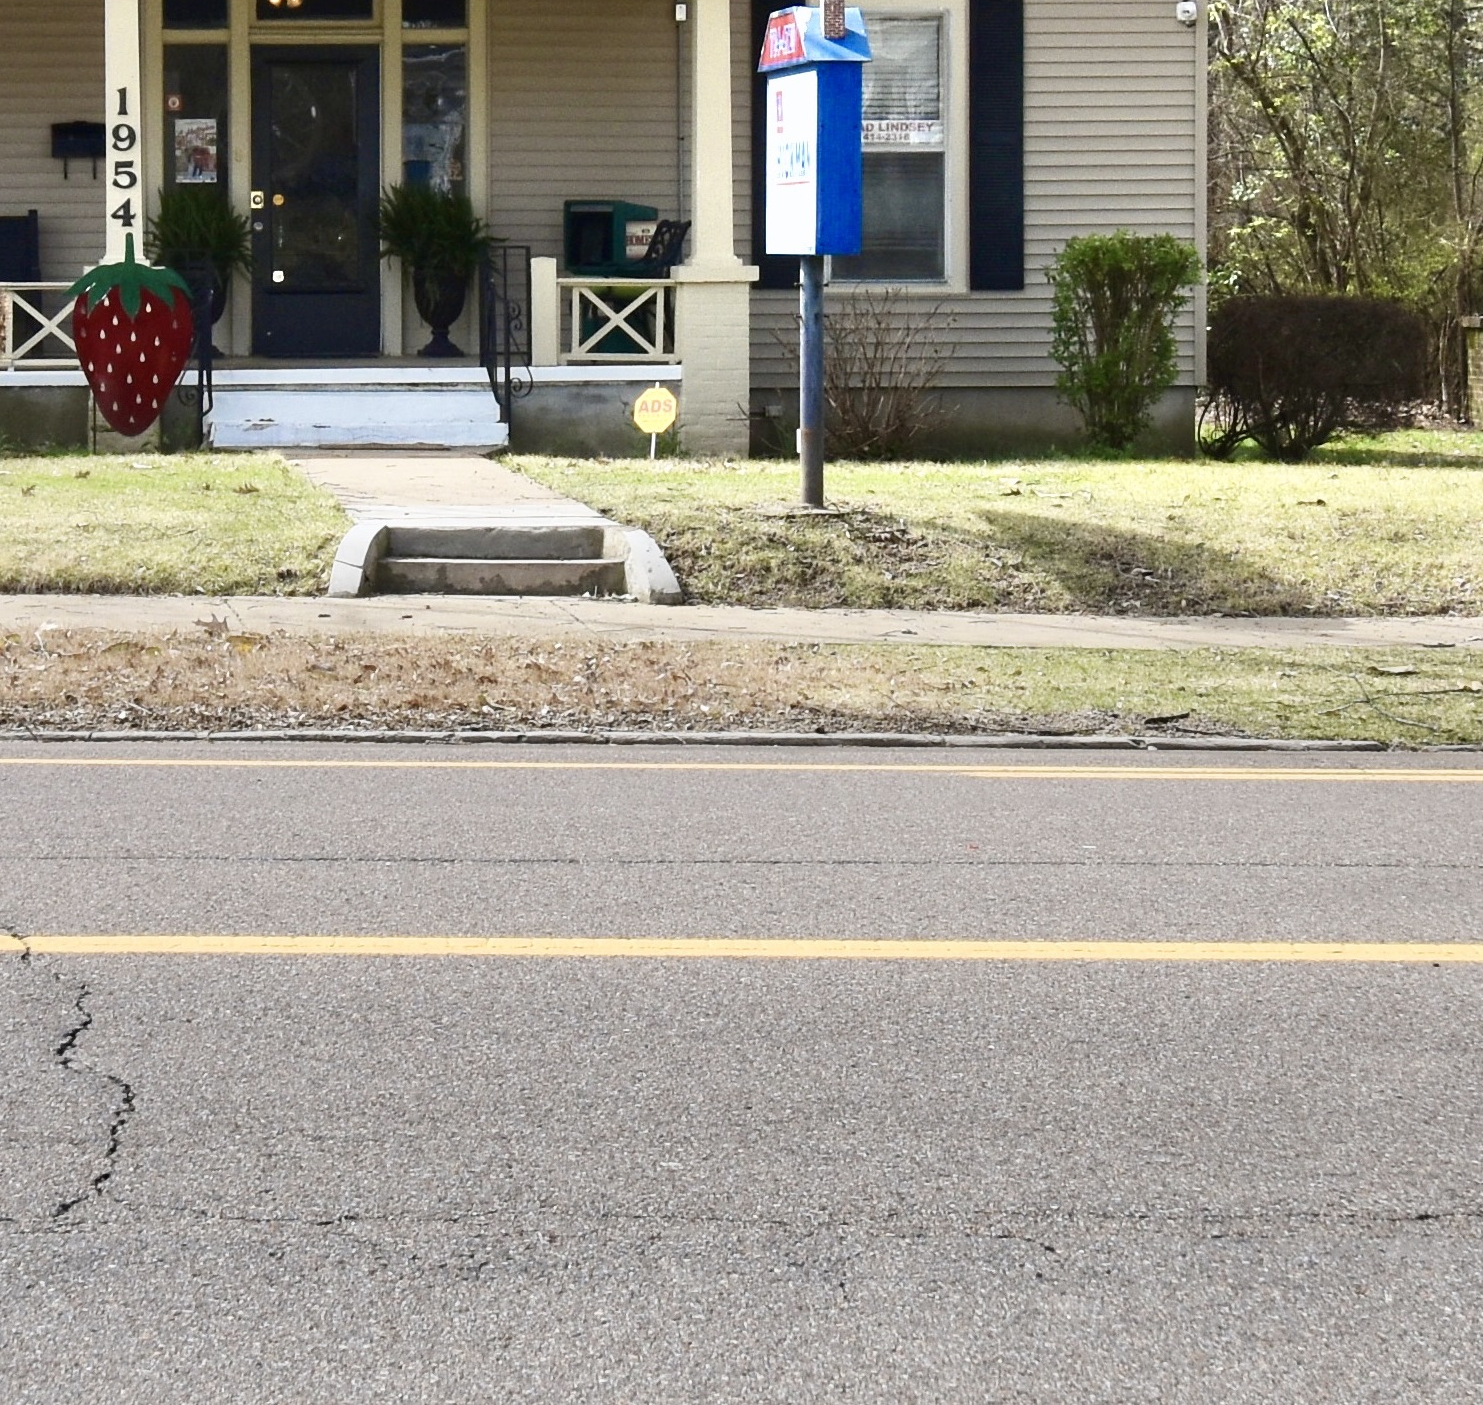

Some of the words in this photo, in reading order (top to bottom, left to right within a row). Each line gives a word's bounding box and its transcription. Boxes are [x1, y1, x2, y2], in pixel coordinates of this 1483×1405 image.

[878, 122, 934, 132] LINDSEY
[111, 87, 137, 227] 1954
[638, 399, 672, 413] ADS
